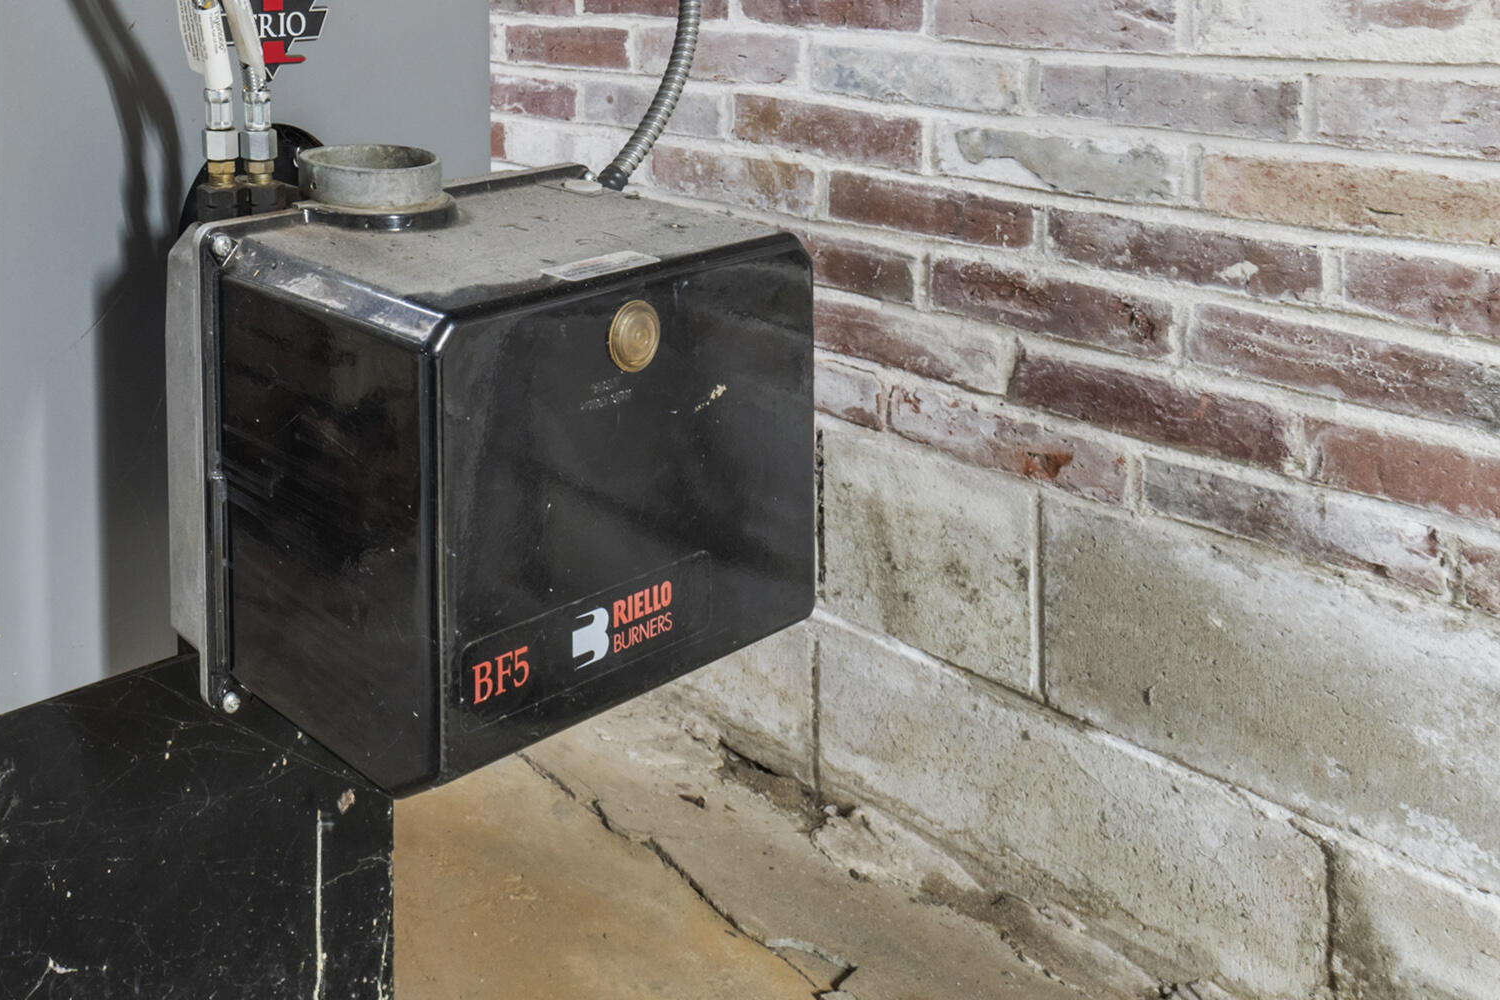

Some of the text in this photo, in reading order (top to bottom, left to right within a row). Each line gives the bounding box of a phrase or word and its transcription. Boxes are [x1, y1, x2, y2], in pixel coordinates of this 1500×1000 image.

[256, 11, 307, 39] RIO
[612, 579, 672, 629] RIELLO
[613, 611, 673, 654] BURNERS
[472, 645, 530, 706] BF5
